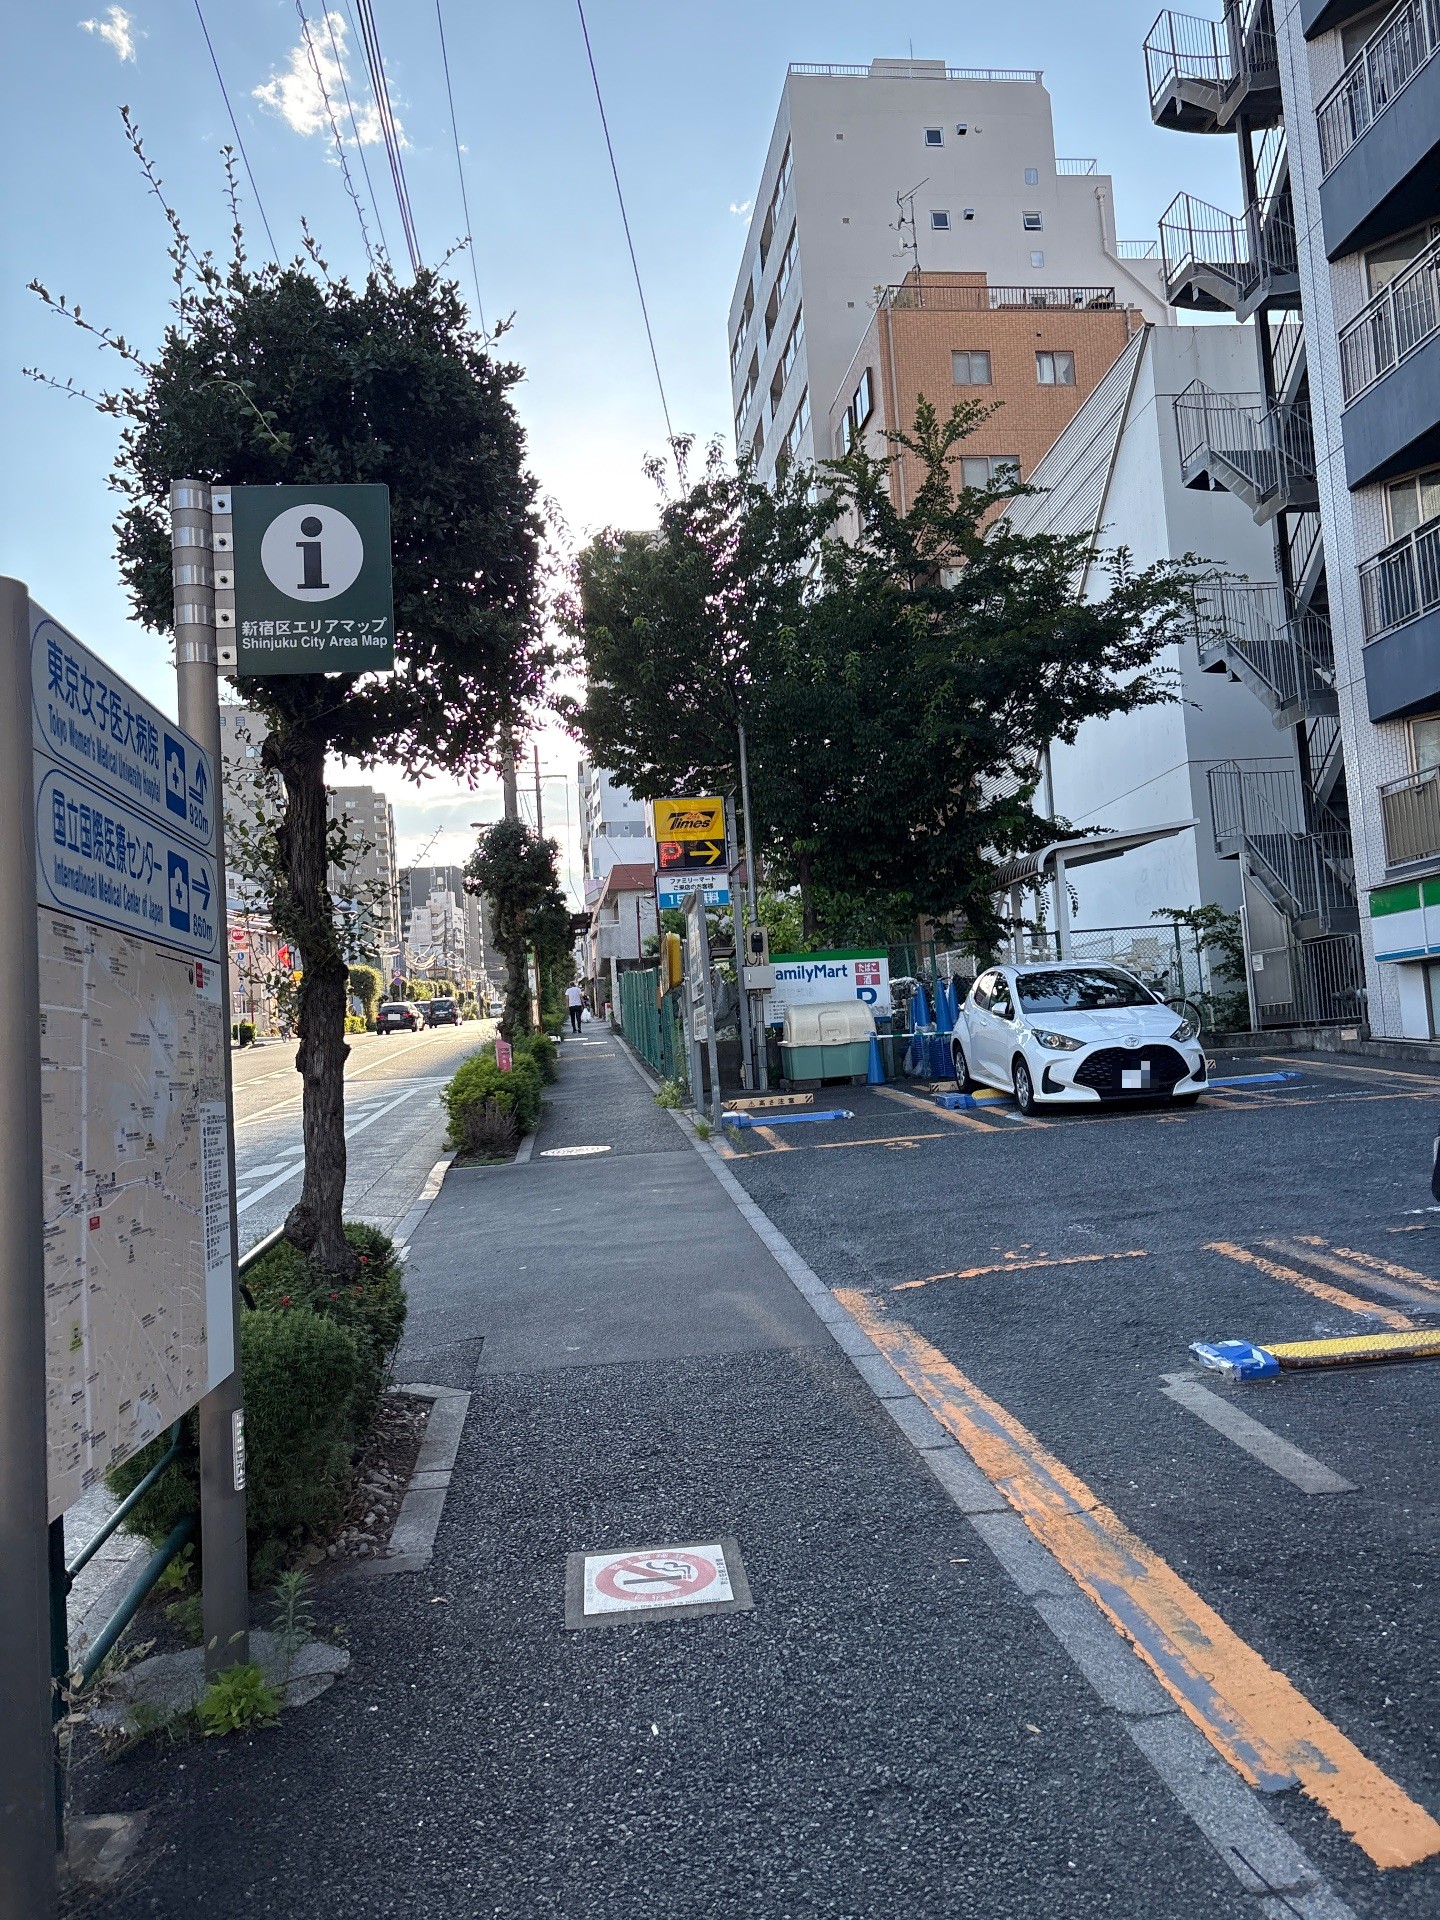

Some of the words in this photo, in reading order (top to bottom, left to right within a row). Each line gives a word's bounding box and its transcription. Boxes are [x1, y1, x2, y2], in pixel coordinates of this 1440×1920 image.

[241, 617, 388, 636] 新宿区エリアマップ
[242, 637, 298, 651] Shinjuku
[301, 636, 326, 650] City
[329, 636, 358, 647] Area
[361, 635, 388, 649] Map
[47, 639, 160, 770] 東京女子医大病院
[48, 703, 68, 746] Tokyo
[69, 717, 96, 761] Women's
[96, 734, 117, 774] Medical
[118, 750, 142, 796] University
[142, 768, 161, 803] Hospital
[189, 802, 209, 835] 920m
[667, 811, 716, 830] Times
[53, 788, 163, 885] 国立国際医療センター
[660, 841, 684, 868] P
[670, 876, 717, 885] ファミリーマート
[54, 855, 98, 899] International
[98, 872, 122, 907] Medical
[123, 883, 141, 914] Center
[142, 893, 148, 918] of
[149, 898, 164, 927] Japan
[774, 964, 849, 983] amilyMart
[858, 963, 878, 973] たばこ
[863, 975, 873, 985] 酒
[758, 1097, 795, 1107] 高さ注意
